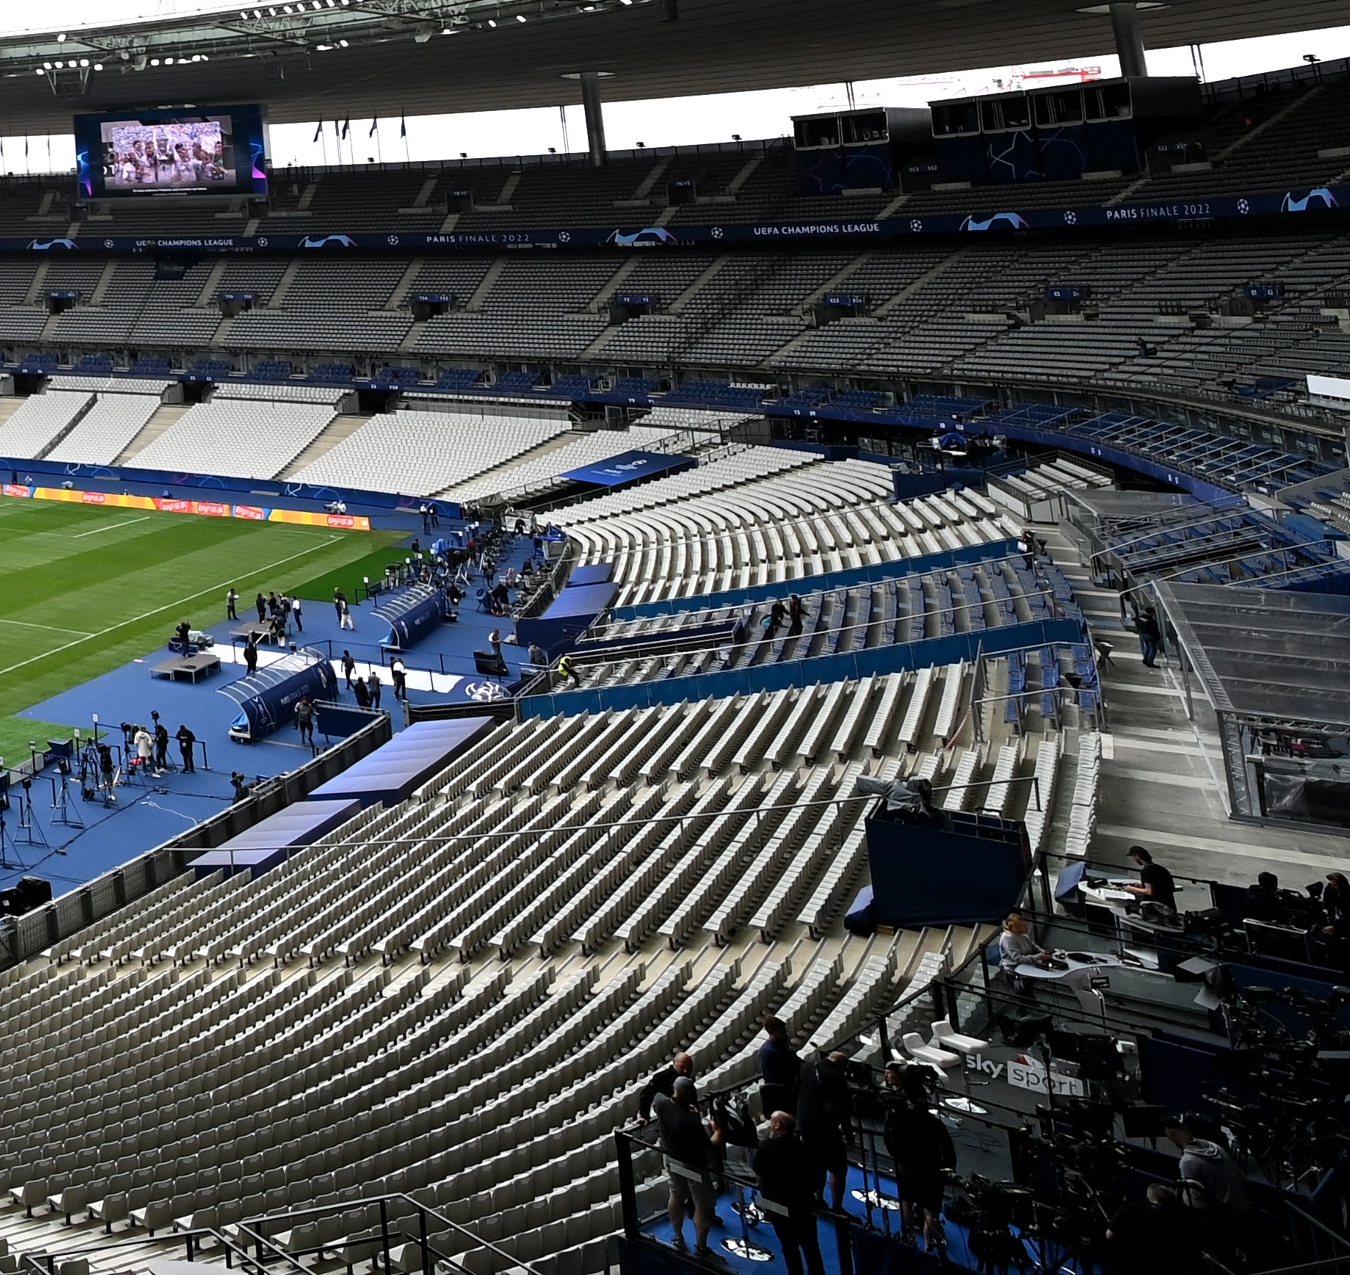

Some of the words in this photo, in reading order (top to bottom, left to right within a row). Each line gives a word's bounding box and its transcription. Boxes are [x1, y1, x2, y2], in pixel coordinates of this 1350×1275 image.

[1106, 209, 1137, 219] PARIS
[1139, 206, 1180, 218] FINALE
[1183, 204, 1210, 215] 2022
[753, 227, 779, 235] UEFA
[781, 225, 839, 234] CHAMPIONS
[842, 223, 880, 233] LEAGUE
[157, 239, 202, 247] CHAMPIONS
[426, 235, 455, 243] PARIS
[458, 234, 496, 242] FINALE
[502, 234, 530, 242] 2022
[966, 1054, 1003, 1079] sky
[1012, 1068, 1077, 1096] sport
